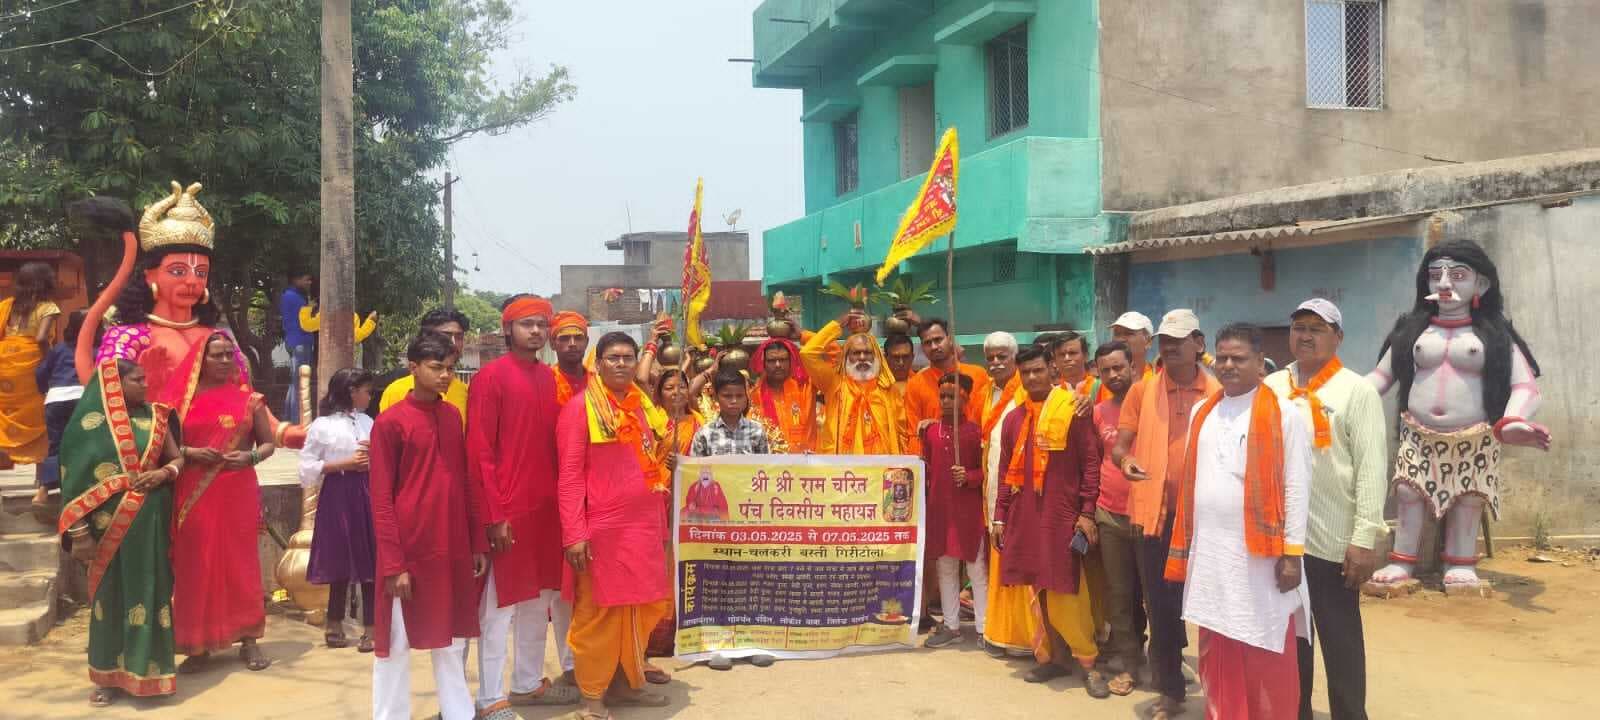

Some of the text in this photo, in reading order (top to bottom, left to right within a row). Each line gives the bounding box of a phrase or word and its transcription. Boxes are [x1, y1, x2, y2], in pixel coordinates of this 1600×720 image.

[751, 470, 868, 494] श्री श्री राम चरित
[738, 497, 878, 522] पंच दिवसीय महायज्ञ
[689, 527, 911, 542] दिनांक 03.05.2025 से 07.05.2025 तक
